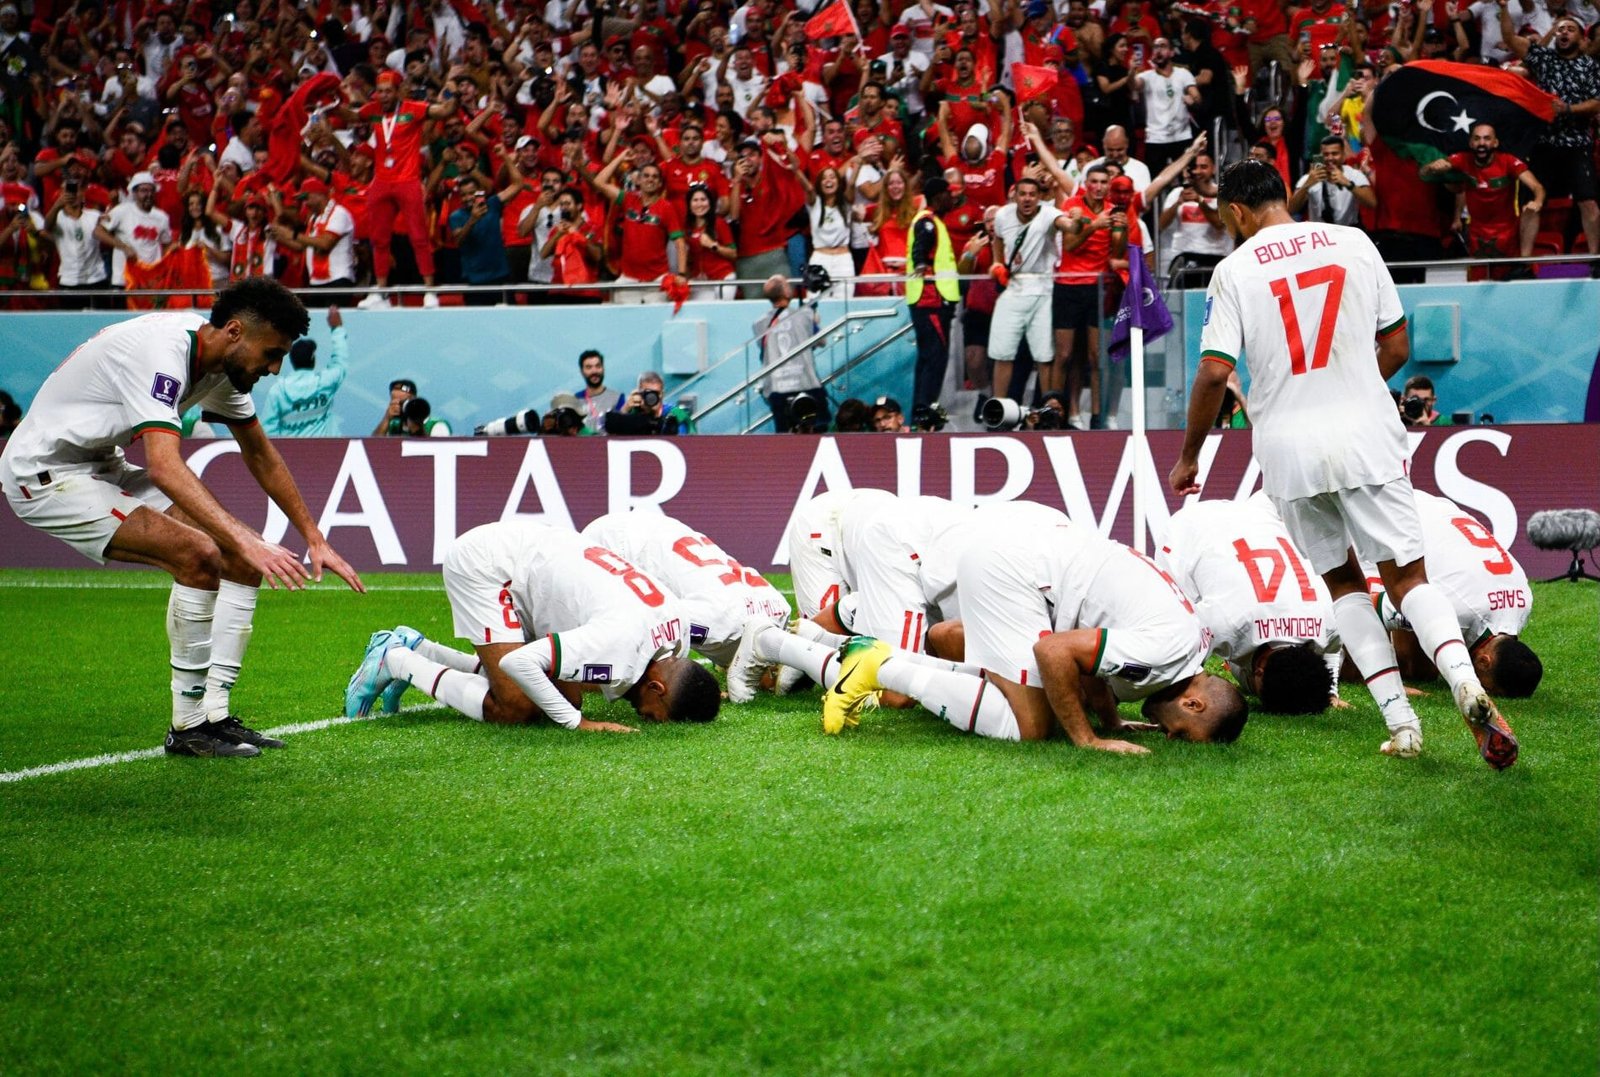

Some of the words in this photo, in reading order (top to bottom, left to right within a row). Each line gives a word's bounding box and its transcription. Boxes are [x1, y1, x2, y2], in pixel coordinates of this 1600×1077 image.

[1254, 230, 1337, 265] BOUFAL
[1269, 264, 1347, 375] 17
[771, 428, 1518, 566] AIRWS
[583, 546, 665, 608] 8
[1232, 536, 1318, 603] 14
[1487, 589, 1526, 611] SAISS
[900, 610, 924, 653] 11
[1254, 617, 1323, 639] ABOUKHLAL
